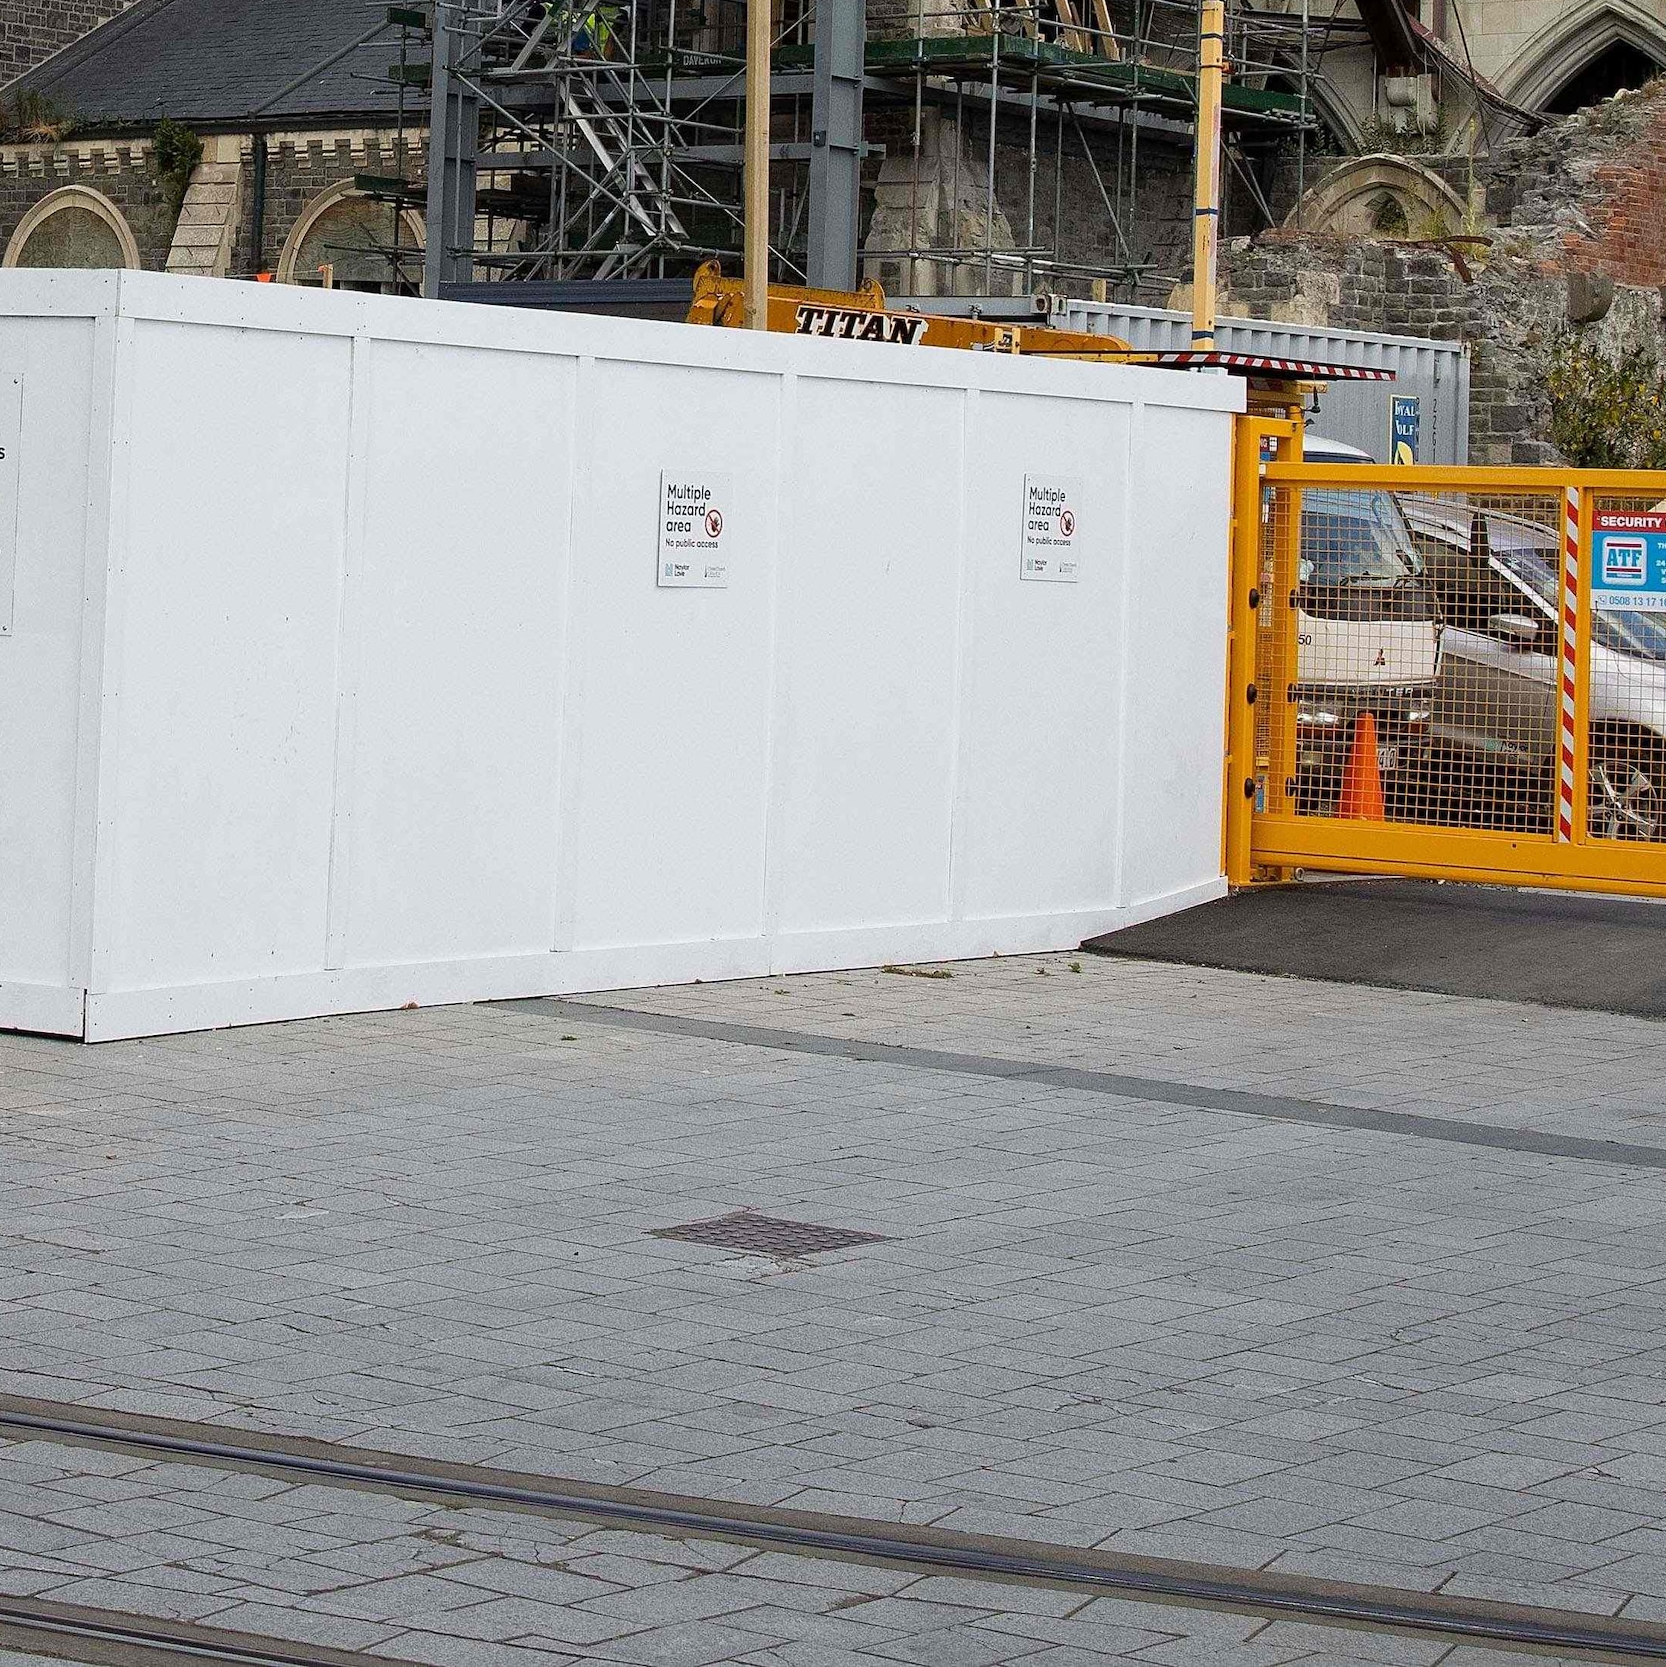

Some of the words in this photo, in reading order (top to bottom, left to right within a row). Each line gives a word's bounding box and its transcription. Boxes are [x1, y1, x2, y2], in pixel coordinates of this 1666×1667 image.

[797, 307, 922, 345] TITAN
[667, 484, 711, 503] Multiple
[1029, 486, 1066, 505] Multiple
[667, 501, 706, 517] Hazard
[1028, 502, 1061, 517] Hazard
[666, 521, 692, 533] area
[1028, 520, 1050, 531] area
[1600, 516, 1662, 528] SECURITY
[665, 538, 674, 547] No
[676, 538, 695, 549] public
[696, 540, 719, 549] access
[1027, 536, 1035, 544] No
[1035, 536, 1052, 546] public
[1053, 538, 1071, 546] access
[1606, 548, 1642, 567] ATF
[1609, 596, 1630, 606] 0508
[1633, 597, 1644, 606] 13
[1646, 597, 1657, 607] 17
